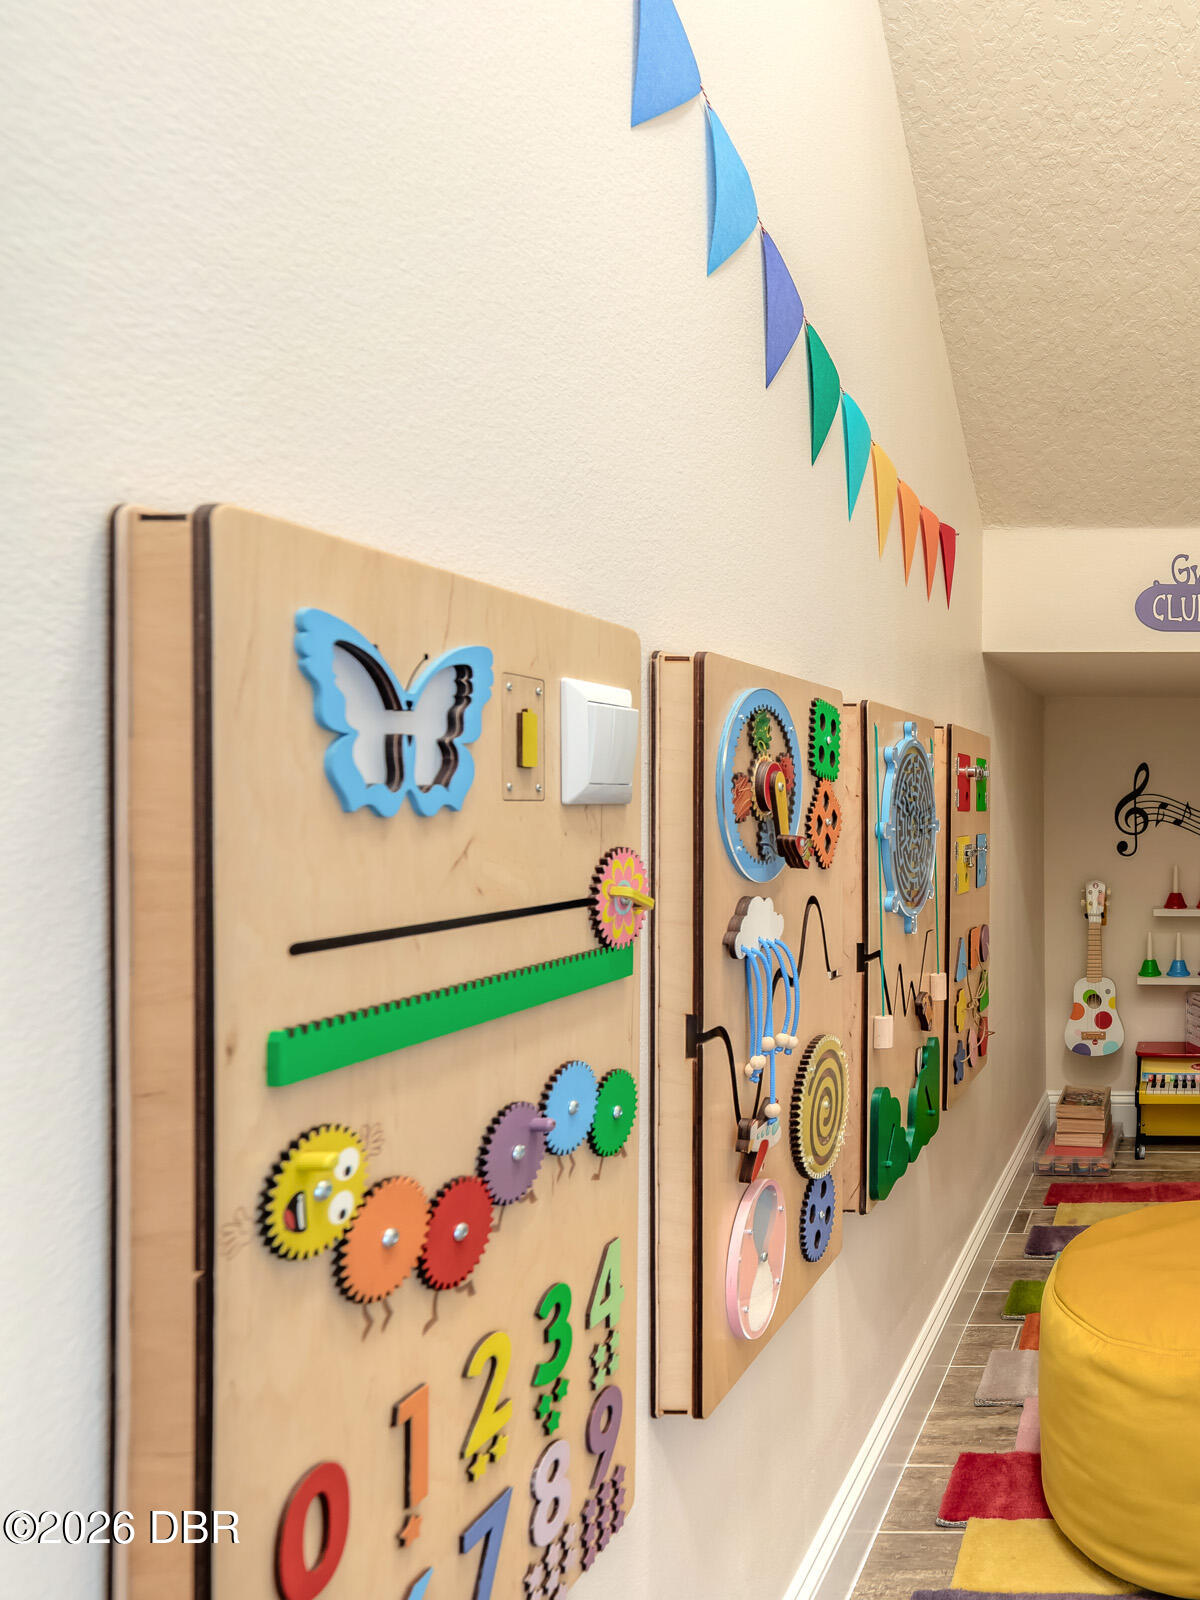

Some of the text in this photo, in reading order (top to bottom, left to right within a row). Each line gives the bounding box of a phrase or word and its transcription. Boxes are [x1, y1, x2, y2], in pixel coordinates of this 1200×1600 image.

[391, 1382, 430, 1509] 1
[460, 1331, 512, 1459] 2
[532, 1282, 573, 1387] 3
[586, 1236, 625, 1330] 4
[459, 1385, 623, 1600] 7 8 9
